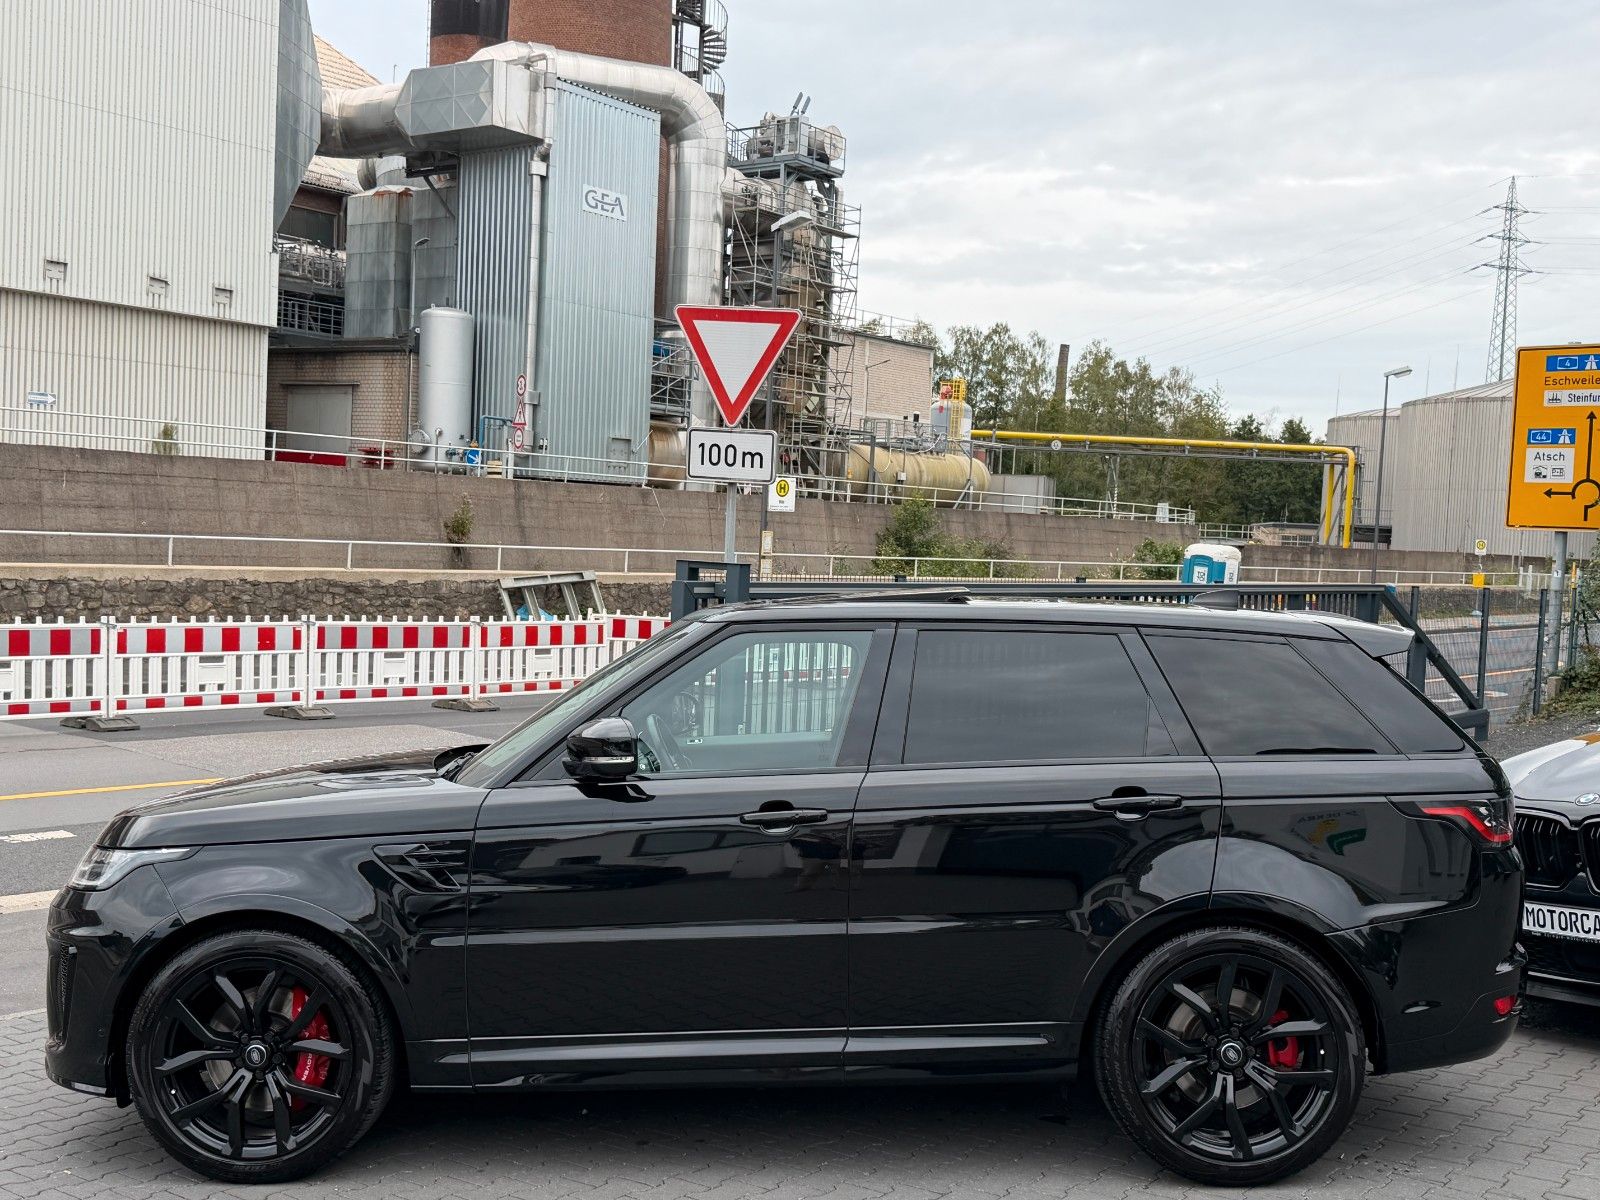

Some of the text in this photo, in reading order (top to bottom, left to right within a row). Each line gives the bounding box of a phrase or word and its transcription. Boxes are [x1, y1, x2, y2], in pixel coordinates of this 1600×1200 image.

[585, 190, 624, 216] GEA
[1544, 375, 1600, 386] Eschweile
[698, 443, 763, 469] 100 m
[1534, 452, 1565, 461] Atsch
[1525, 906, 1600, 936] MOTORCA
